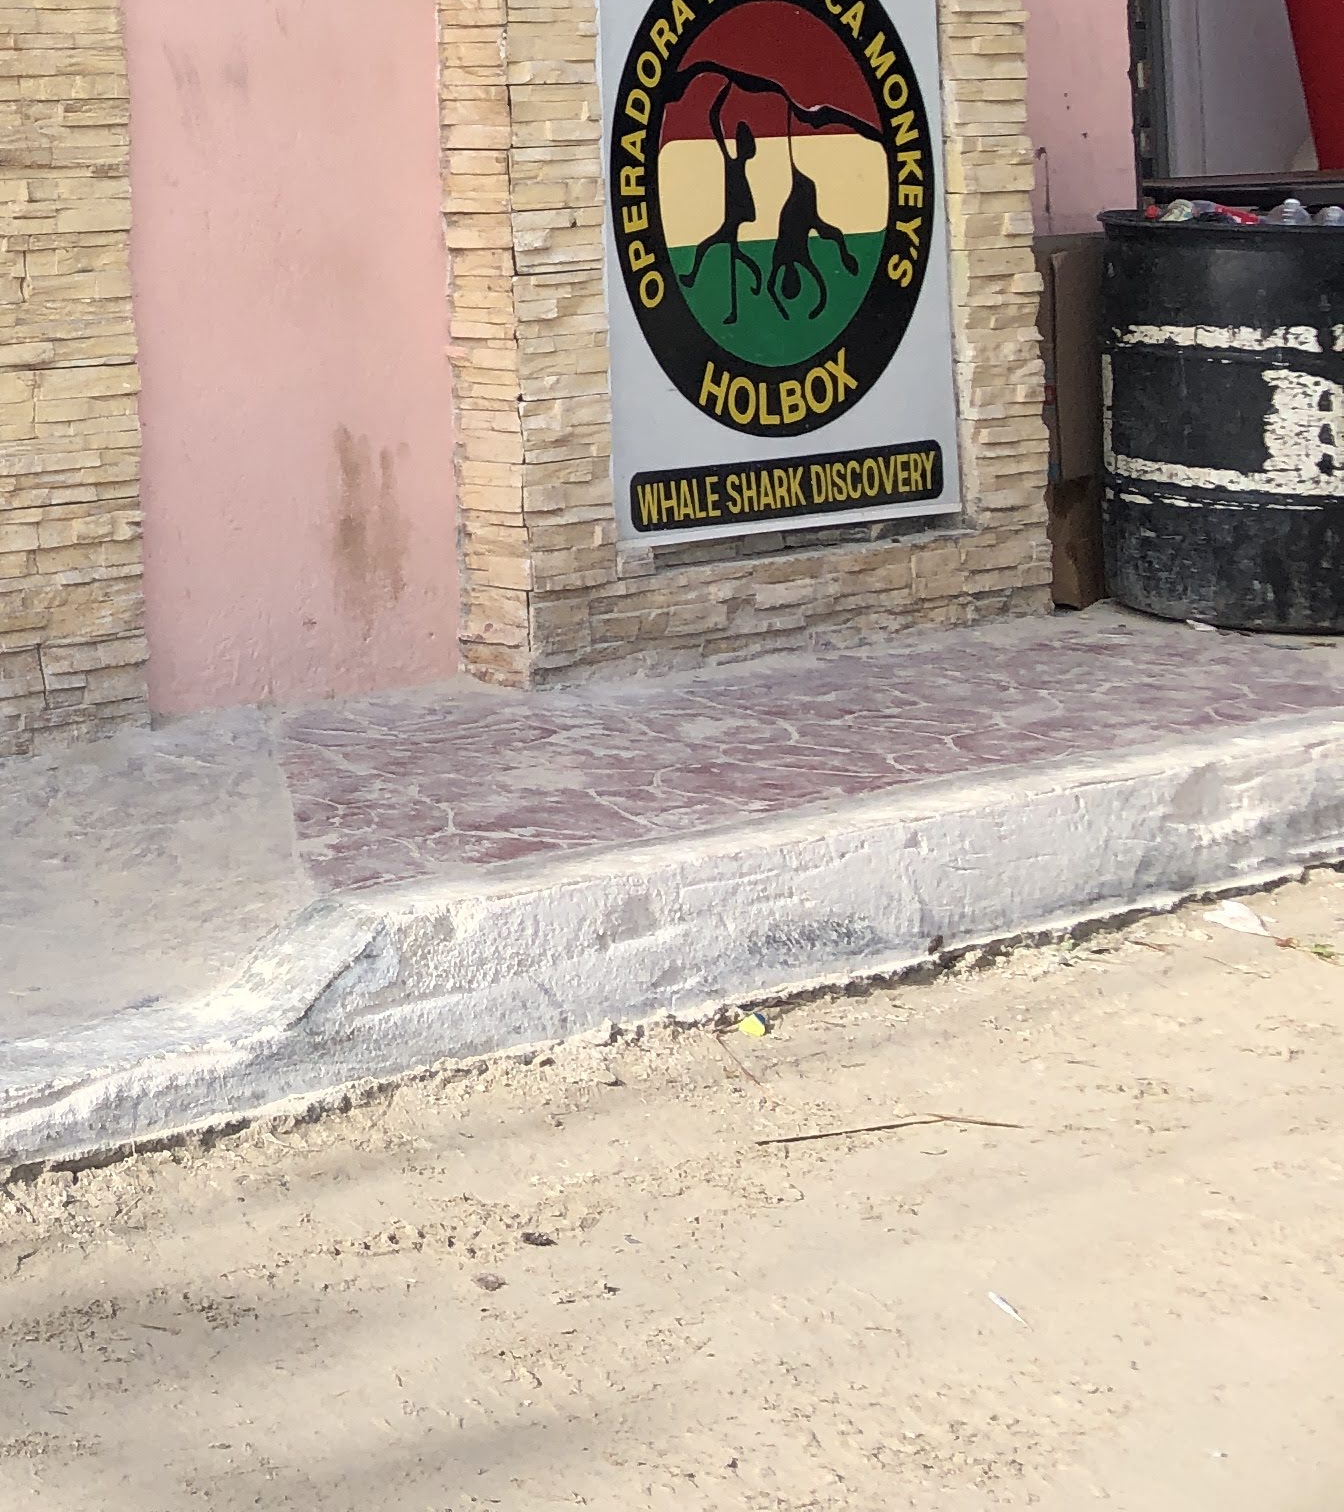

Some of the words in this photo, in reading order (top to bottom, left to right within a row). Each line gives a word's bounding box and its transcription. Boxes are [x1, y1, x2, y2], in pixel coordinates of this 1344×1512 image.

[863, 30, 924, 288] MONKEY'S
[699, 347, 858, 425] HOLBOX
[637, 473, 721, 525] WHALE
[725, 465, 806, 514] SHARK
[809, 450, 937, 505] DISCOVERY
